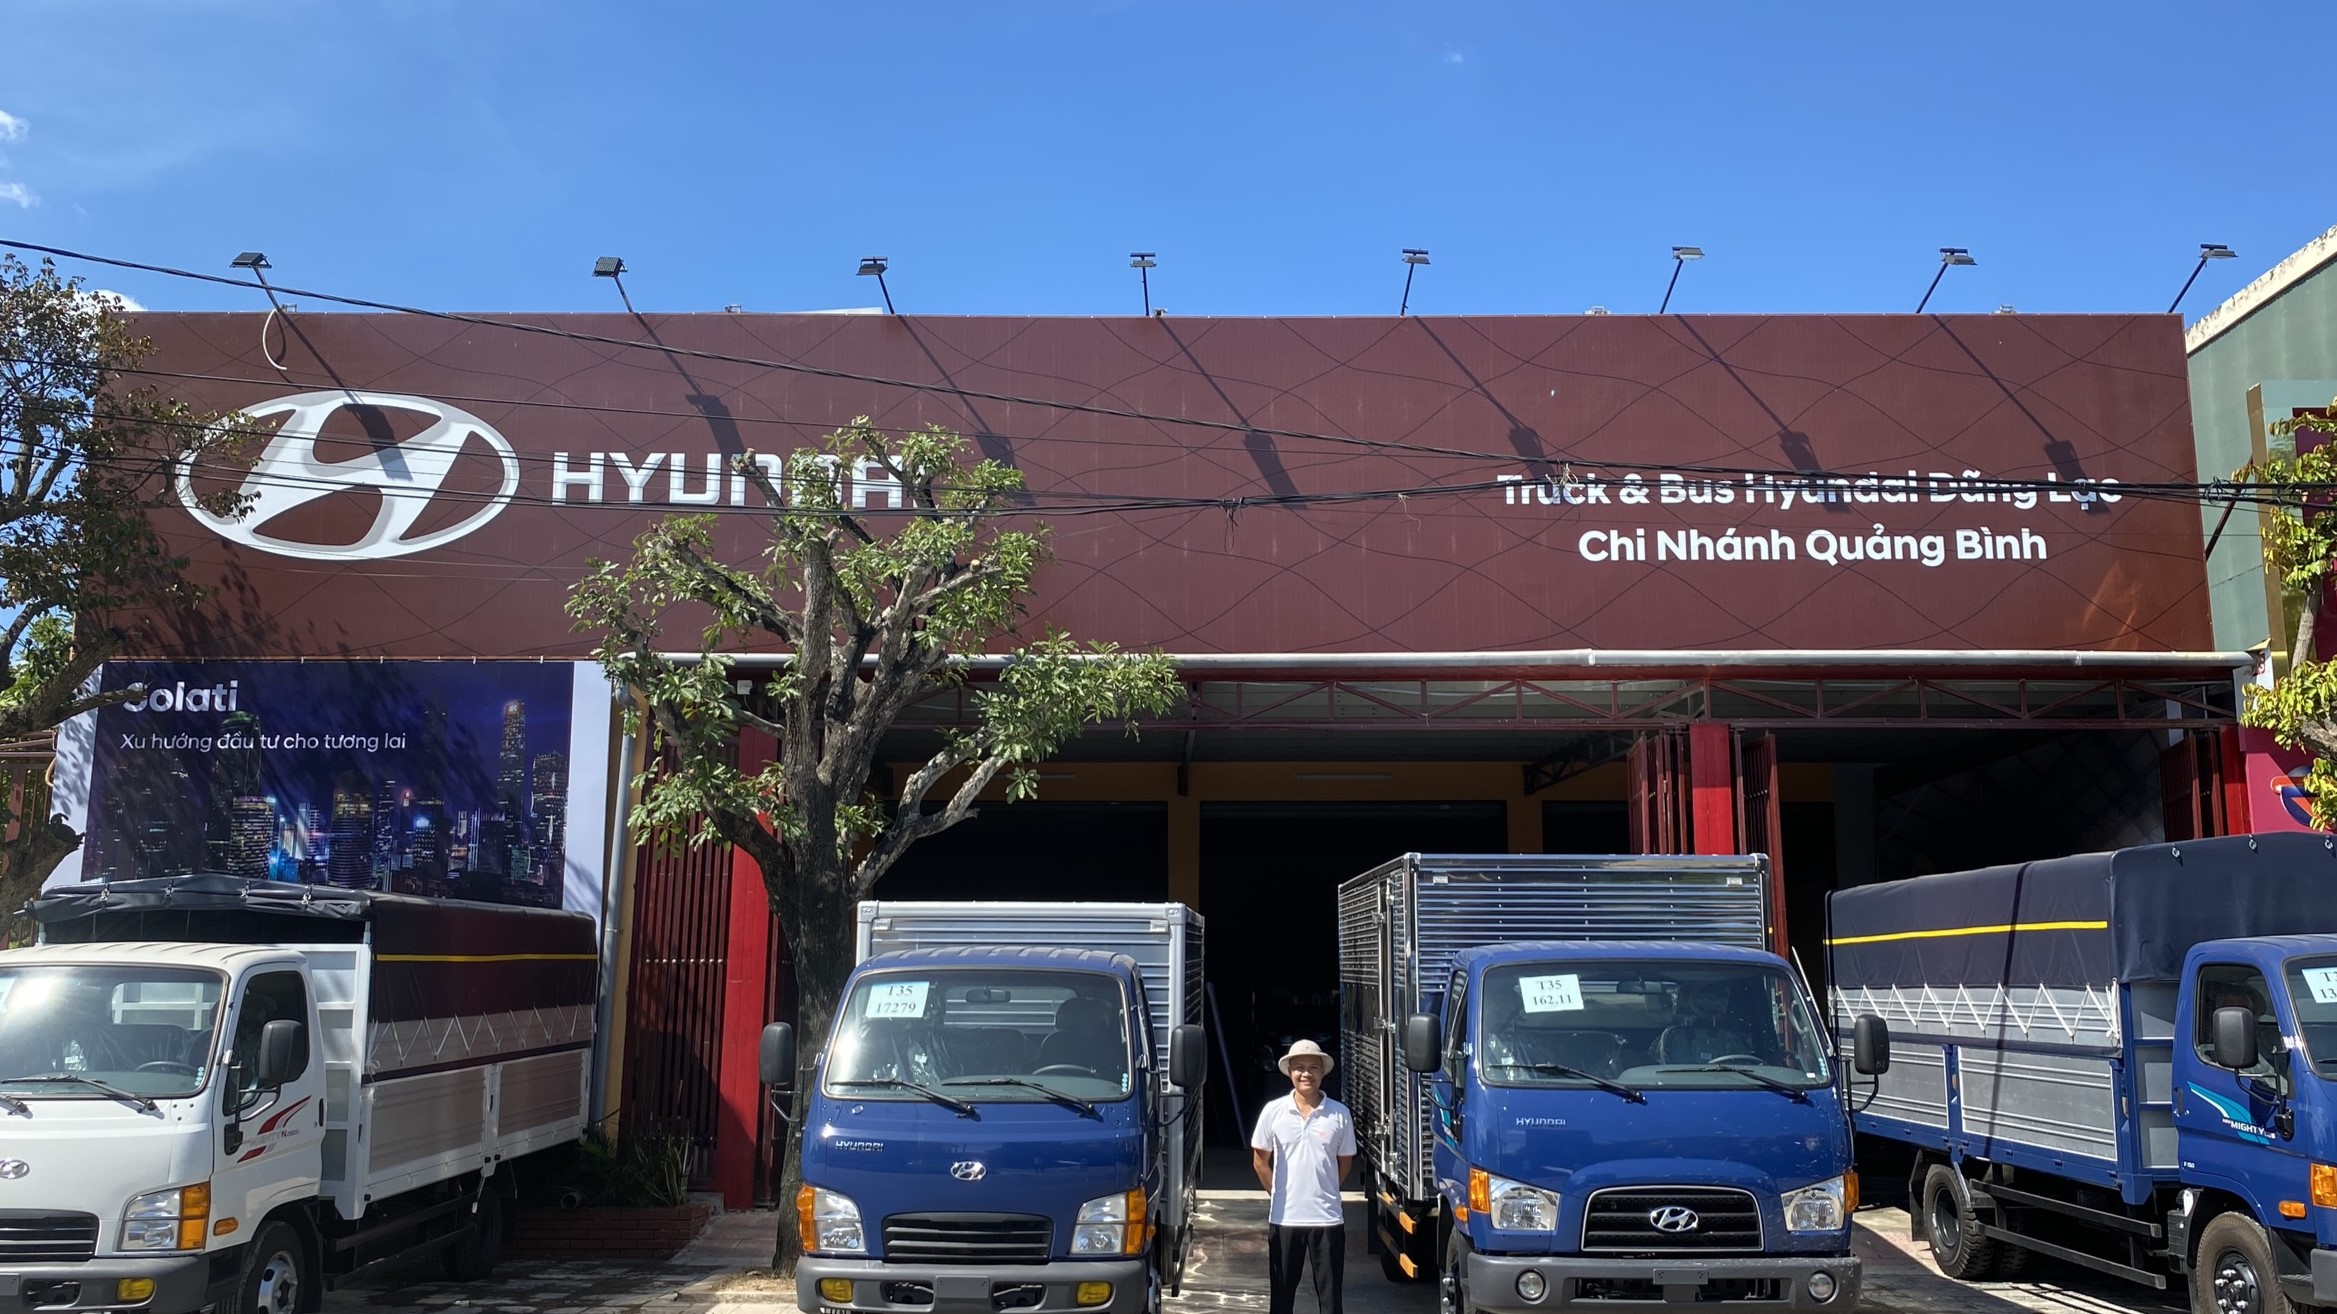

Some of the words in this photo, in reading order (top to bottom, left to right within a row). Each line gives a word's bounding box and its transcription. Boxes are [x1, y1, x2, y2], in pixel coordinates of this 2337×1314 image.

[551, 451, 918, 508] HYUNDA
[1497, 473, 1611, 505] Truck
[1619, 473, 1650, 505] &
[1660, 473, 1735, 503] Bus
[1745, 470, 1918, 510] Hyundai
[1929, 469, 2037, 510] Dũng
[2047, 472, 2123, 510] Lạc
[1579, 528, 1645, 562] Chi
[1657, 528, 1796, 561] Nhánh
[1805, 522, 1945, 567] Quảng
[1956, 526, 2047, 560] Bình
[120, 733, 146, 749] Xu
[151, 732, 212, 752] hướng
[217, 731, 254, 749] đầu
[260, 734, 280, 749] tư
[283, 733, 319, 749] cho
[324, 734, 379, 752] tương
[384, 733, 406, 749] lai
[2319, 971, 2337, 982] T
[887, 985, 913, 996] T35
[1536, 979, 1562, 991] T35
[876, 1002, 916, 1013] 17279
[1516, 1117, 1566, 1126] HYUNDAI
[2230, 1120, 2264, 1136] MIGHTY
[835, 1140, 884, 1151] HYUNDAI
